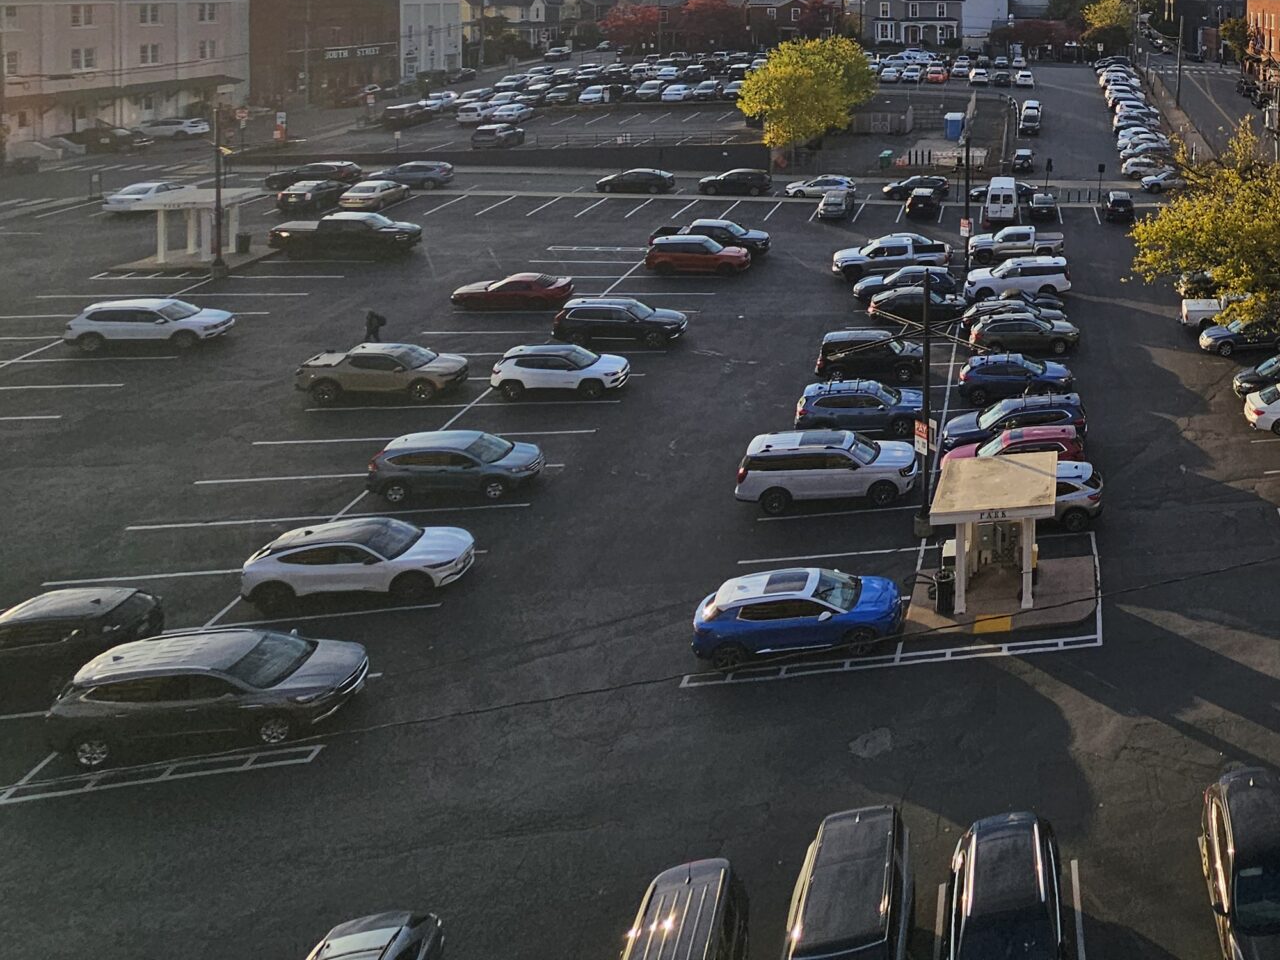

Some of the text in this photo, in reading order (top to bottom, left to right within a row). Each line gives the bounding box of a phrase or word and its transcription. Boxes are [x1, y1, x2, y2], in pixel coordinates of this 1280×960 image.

[325, 47, 380, 59] SOUTH STREET
[980, 511, 1007, 519] PARK
